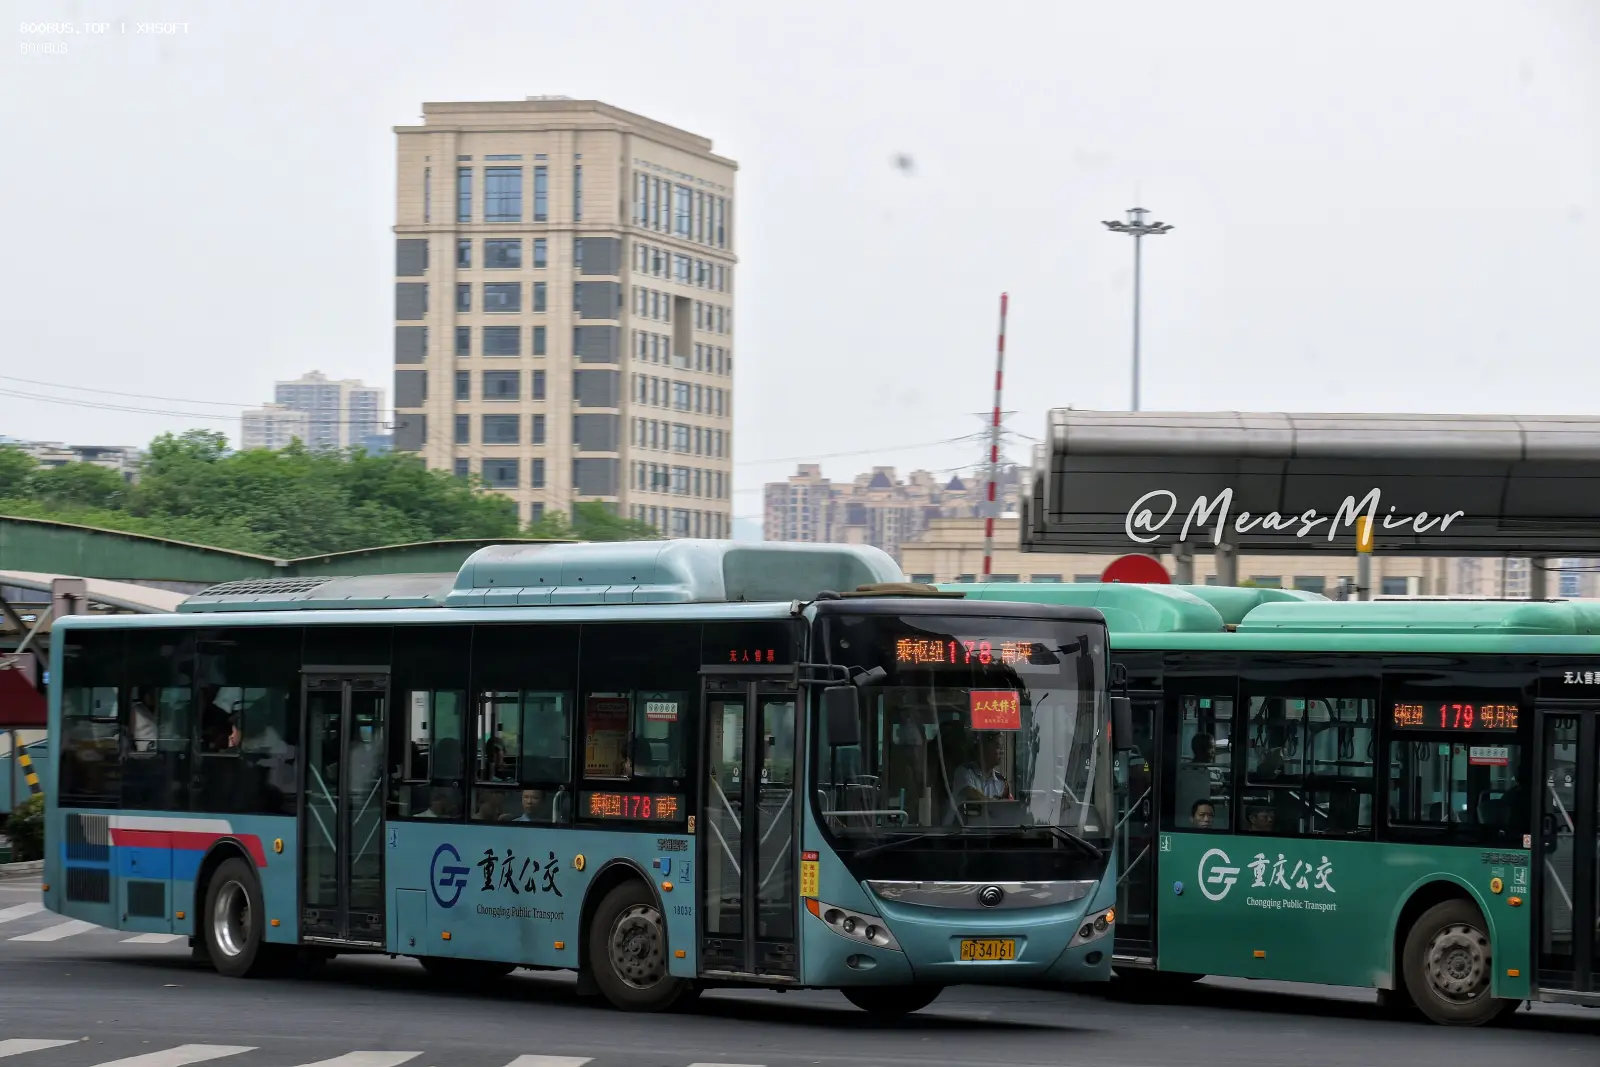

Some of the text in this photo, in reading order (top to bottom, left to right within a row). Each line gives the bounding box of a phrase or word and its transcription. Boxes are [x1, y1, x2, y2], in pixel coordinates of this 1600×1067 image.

[947, 640, 992, 664] 178
[1440, 704, 1474, 729] 179
[622, 795, 651, 818] 178
[476, 848, 563, 898] 重庆公交
[1246, 852, 1336, 893] 重庆公交
[476, 903, 565, 922] Chongqing Public Transport
[1246, 896, 1337, 912] Chongqing Public Transport
